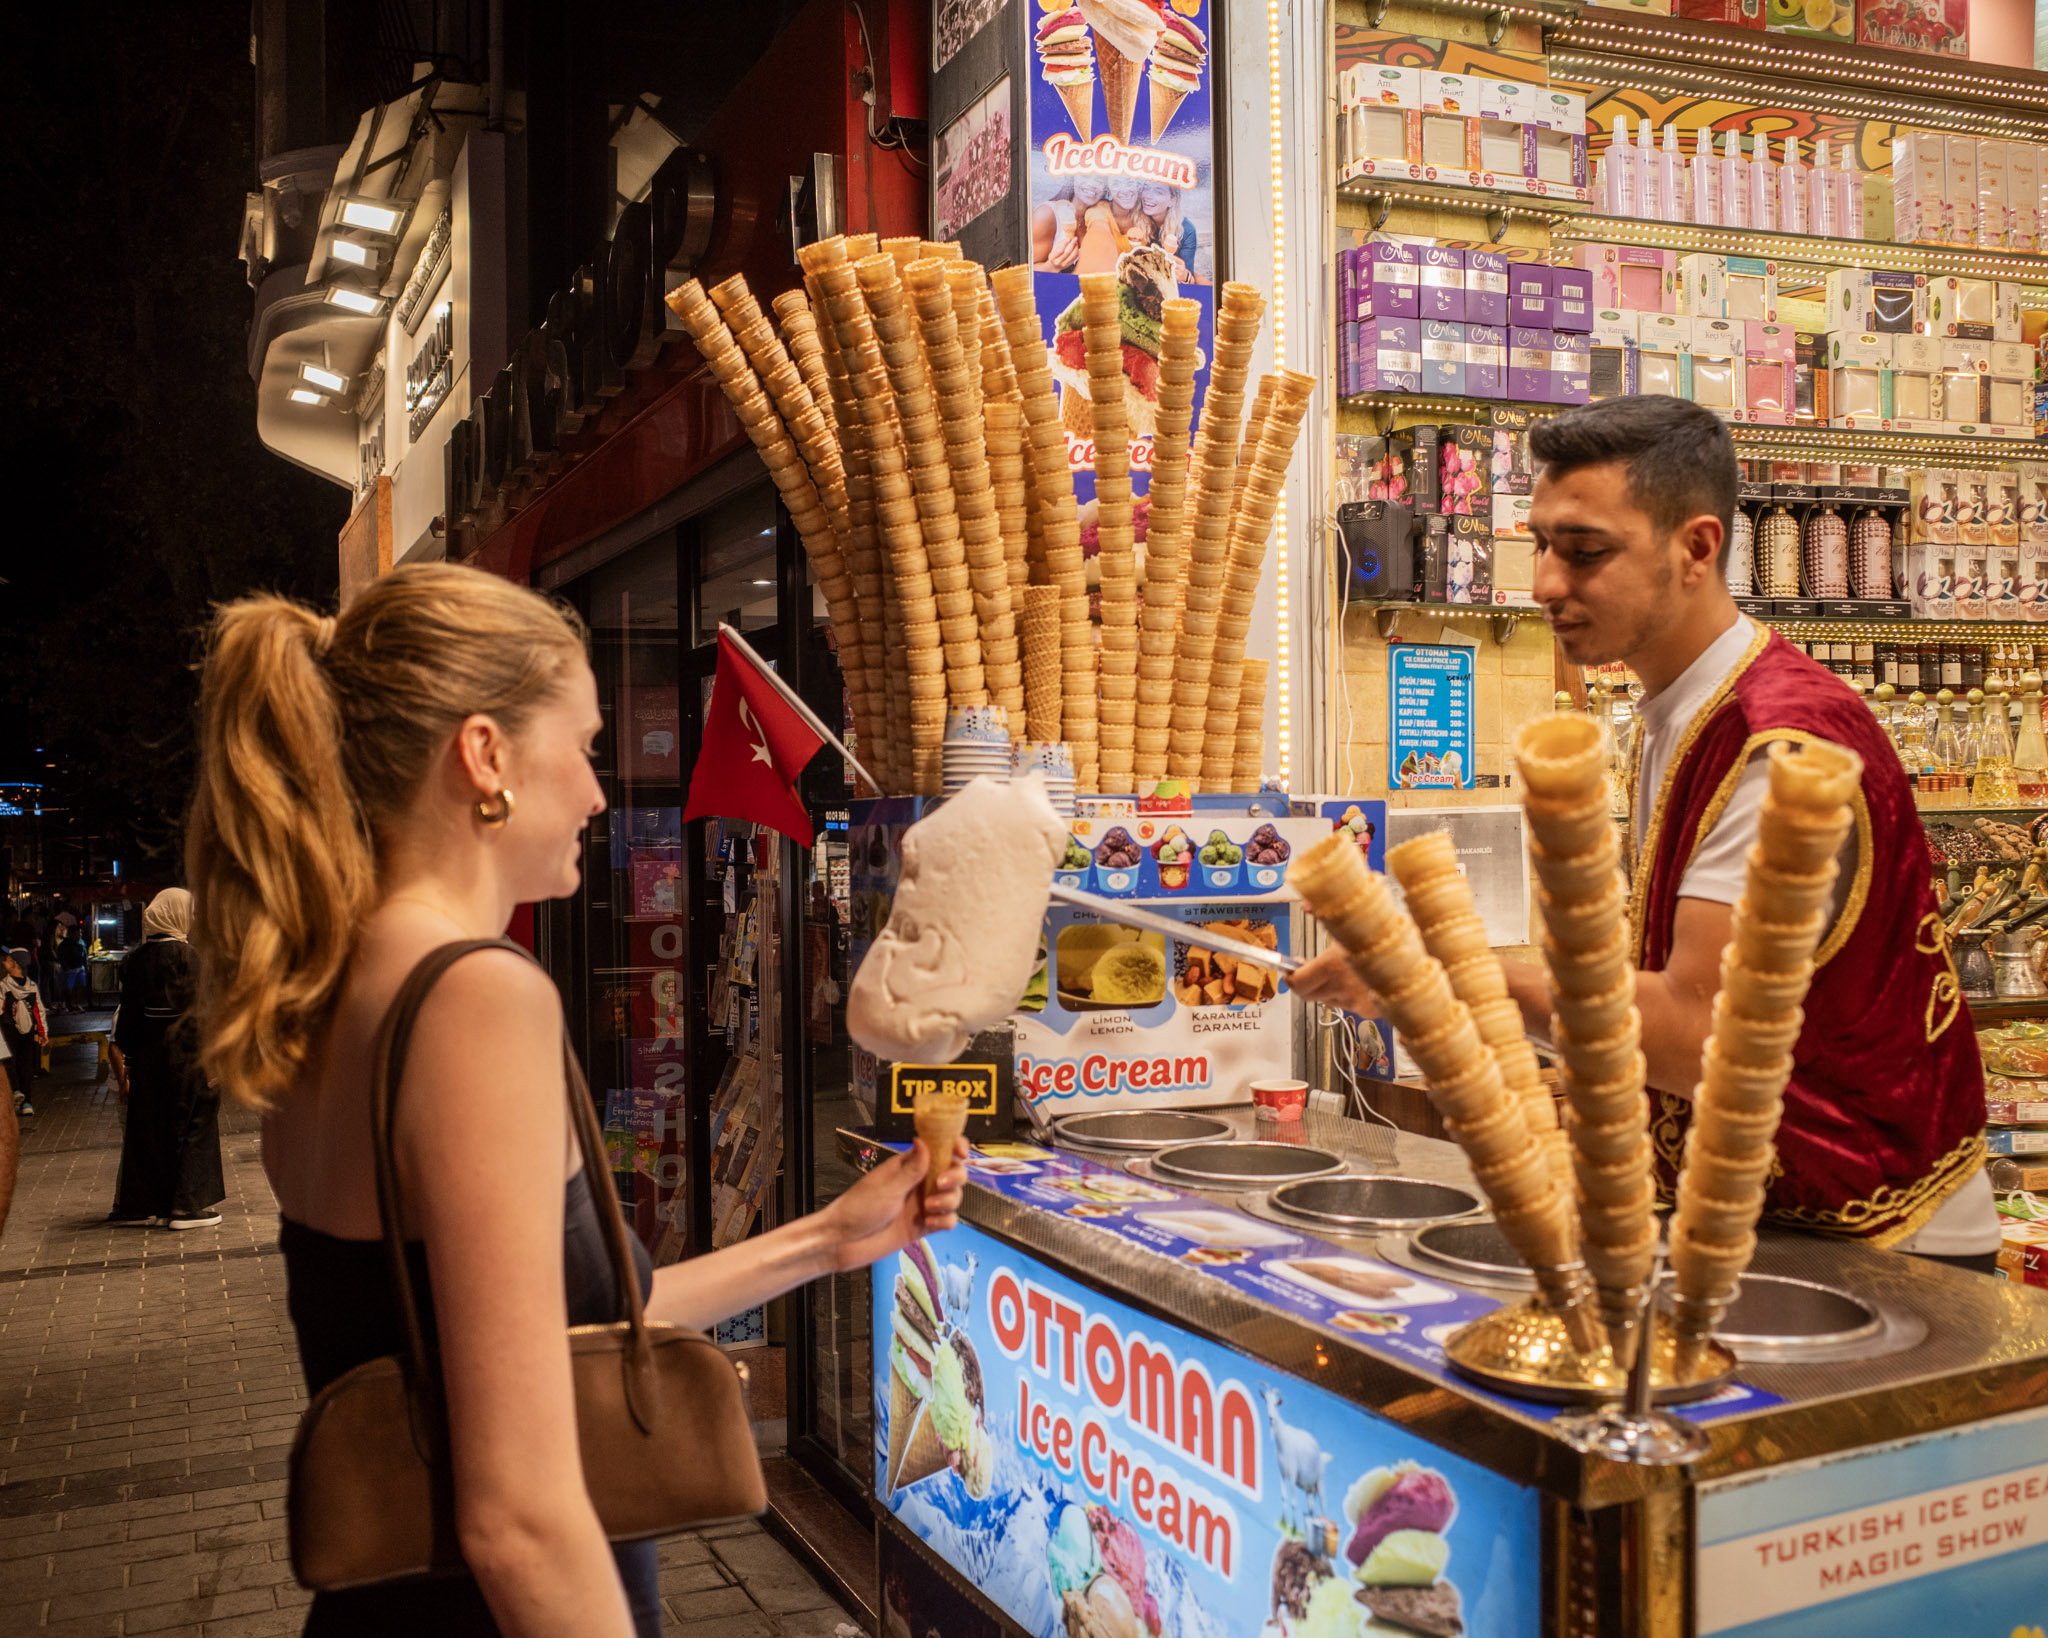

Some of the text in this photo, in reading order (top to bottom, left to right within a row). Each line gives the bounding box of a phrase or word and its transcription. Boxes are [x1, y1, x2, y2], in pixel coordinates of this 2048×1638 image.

[1889, 28, 1928, 49] BABA
[1415, 648, 1449, 657] OTTOMAN
[1399, 676, 1416, 686] KÜÇÜK
[1420, 678, 1437, 686] SMALL
[1415, 688, 1435, 696] MIDDLE
[1399, 697, 1416, 706] BÜYÜK
[1423, 739, 1439, 748] MIXED
[1409, 774, 1454, 784] Ice Cream
[1184, 906, 1266, 916] STRAWBERRY
[1092, 1014, 1132, 1025] LİMON
[1192, 1009, 1262, 1021] KARAMELLİ
[1090, 1026, 1134, 1036] LEMON
[1192, 1022, 1261, 1033] CARAMEL
[1082, 1054, 1208, 1091] Cream
[902, 1078, 988, 1099] TIP BOX
[612, 1106, 657, 1119] Emergency
[989, 1272, 1258, 1490] OTTOMAN
[1018, 1380, 1232, 1578] Ice Cream
[1755, 1511, 1904, 1567] TURKISH
[1919, 1494, 1968, 1527] ICE
[1818, 1514, 2029, 1590] MAGIC SHOW
